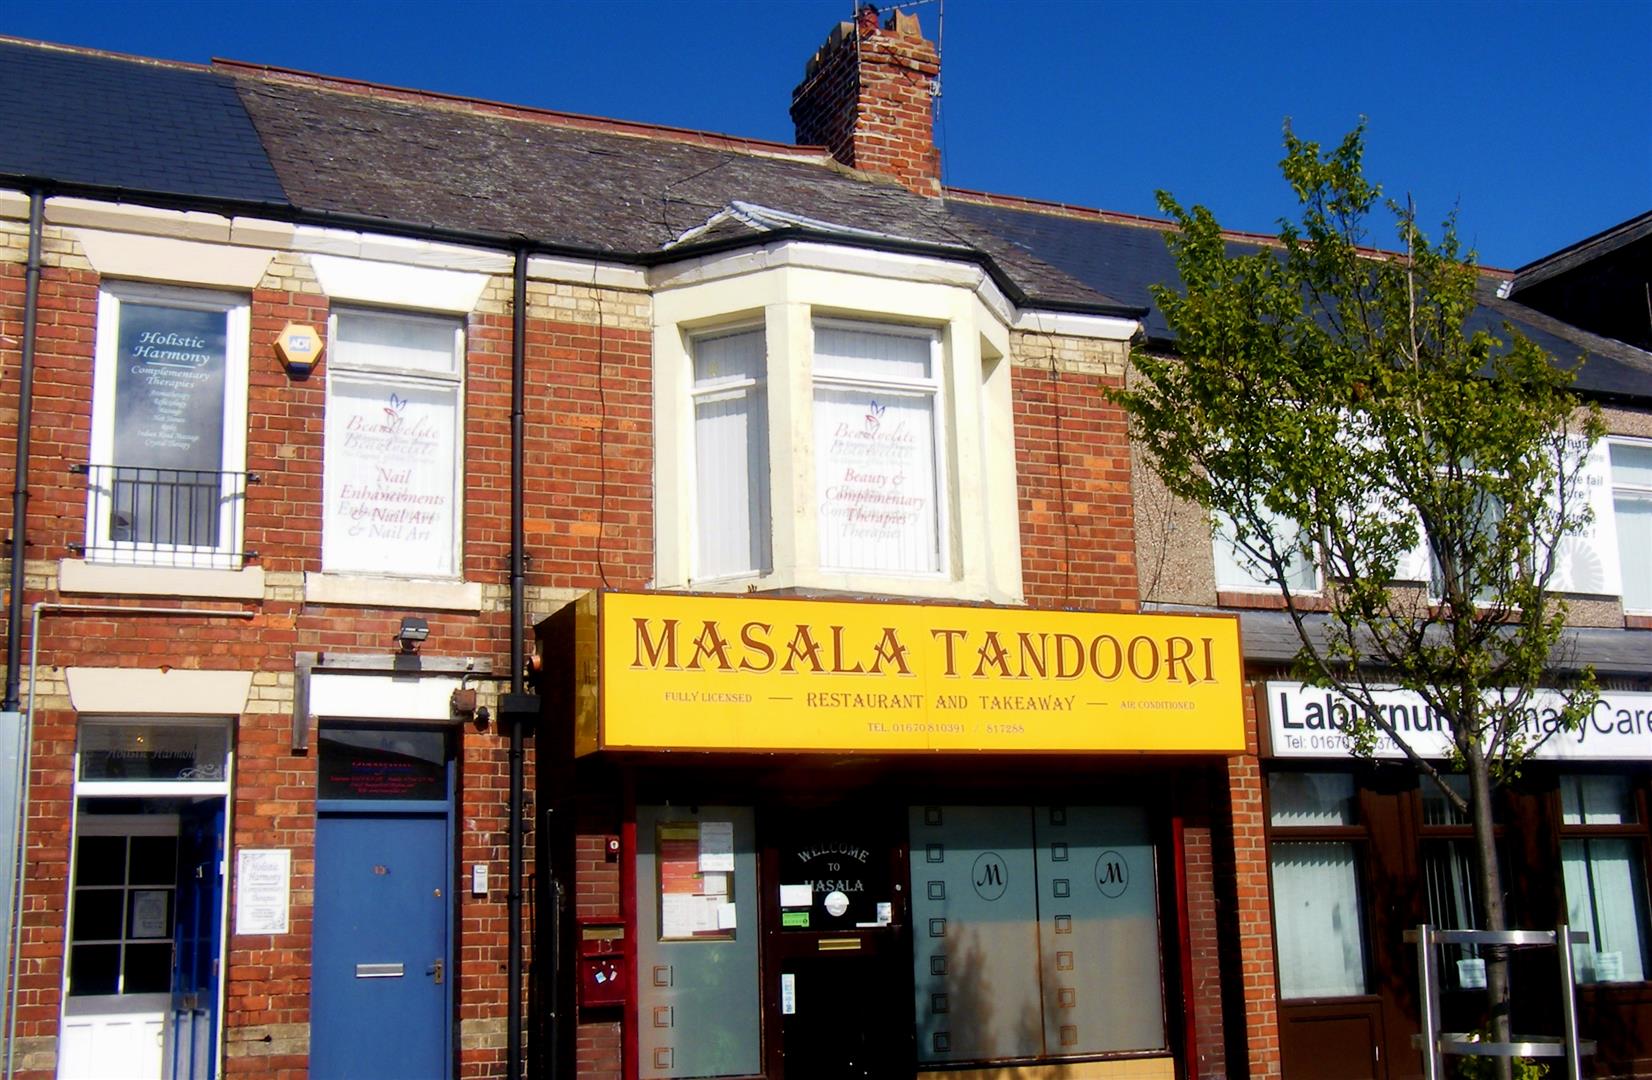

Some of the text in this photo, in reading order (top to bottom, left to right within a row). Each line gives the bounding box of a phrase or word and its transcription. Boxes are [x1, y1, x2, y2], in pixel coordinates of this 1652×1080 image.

[140, 331, 206, 349] Holistic
[132, 345, 211, 367] Harmony
[145, 376, 195, 389] Therapies
[376, 467, 412, 484] Nail
[628, 617, 1219, 686] MASALA TANDOORI
[665, 690, 1196, 712] FULLY LICENSED RESTAURANT AND TAKEAWAY AIR CONDITIONED
[1284, 735, 1307, 750] Tel:
[797, 840, 870, 864] WELCOME
[827, 862, 841, 872] TO
[976, 863, 1003, 887] M
[1099, 862, 1124, 885] M
